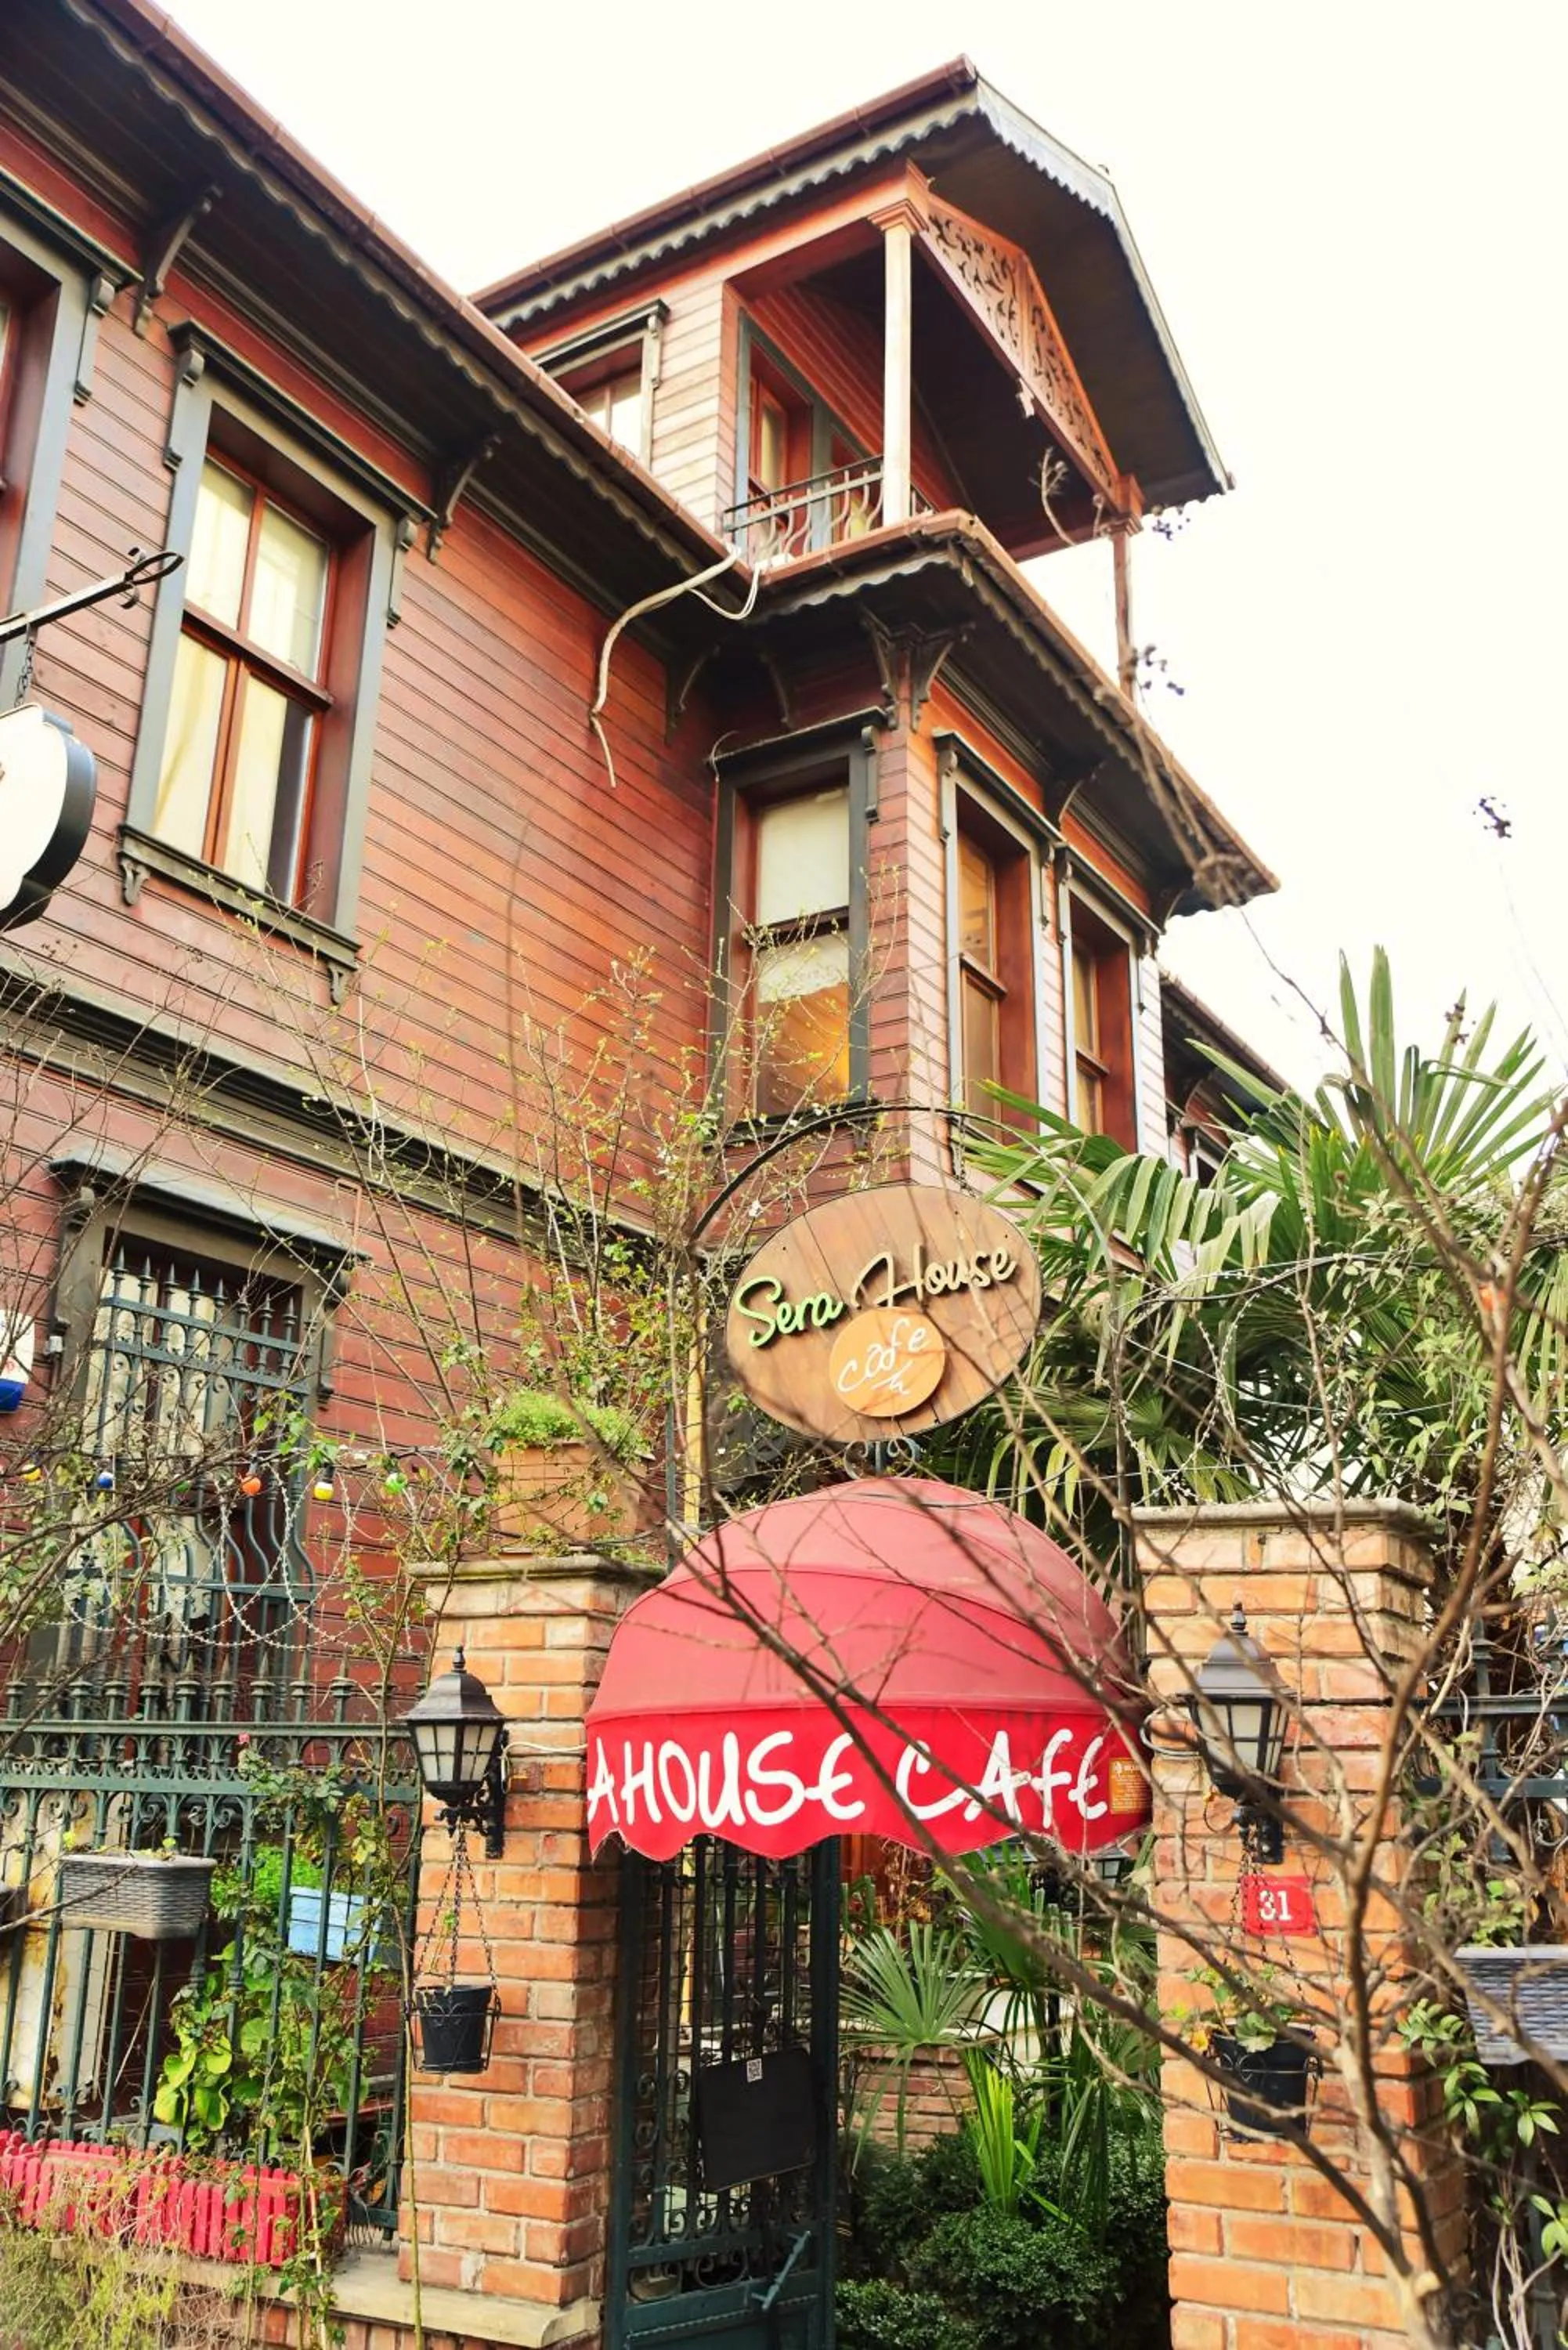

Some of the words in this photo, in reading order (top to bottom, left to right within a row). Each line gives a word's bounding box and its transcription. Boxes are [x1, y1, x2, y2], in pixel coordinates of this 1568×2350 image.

[735, 1275, 845, 1348] Sera
[851, 1243, 1018, 1311] House
[587, 1730, 865, 1828] AHOUSE
[1259, 1889, 1292, 1922] 31
